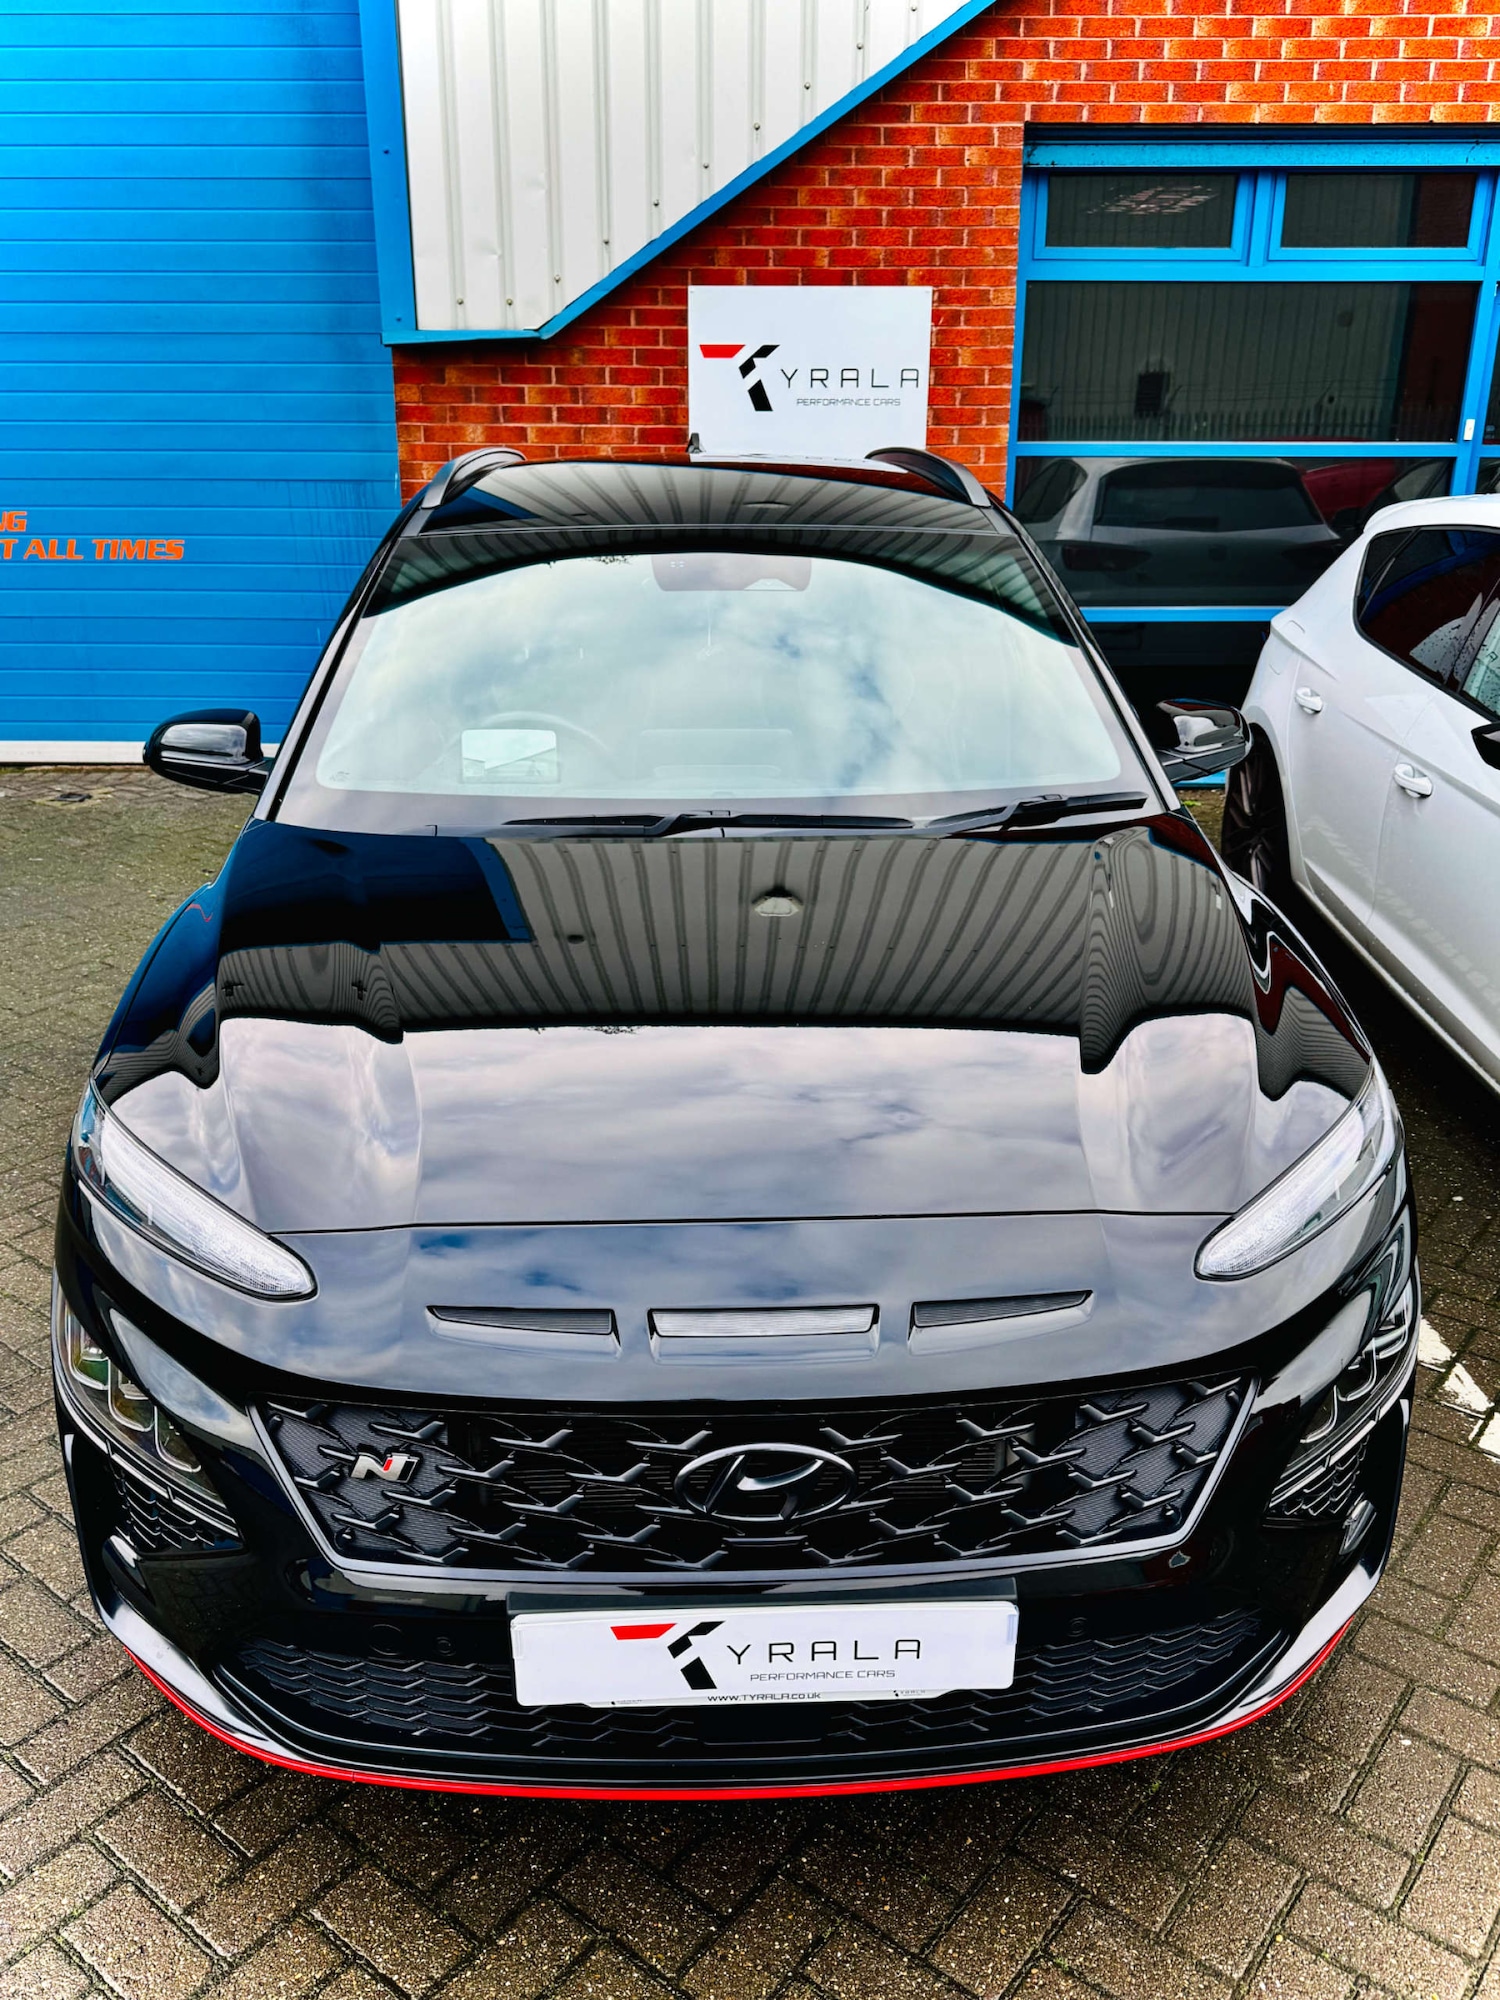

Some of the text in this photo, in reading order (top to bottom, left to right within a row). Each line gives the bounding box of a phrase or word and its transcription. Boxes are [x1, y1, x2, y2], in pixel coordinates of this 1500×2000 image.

[796, 398, 901, 407] PERFORMANCE CARS
[23, 538, 84, 560] ALL
[92, 539, 185, 561] TIMES
[750, 1669, 896, 1682] PERFORMANCE CARS
